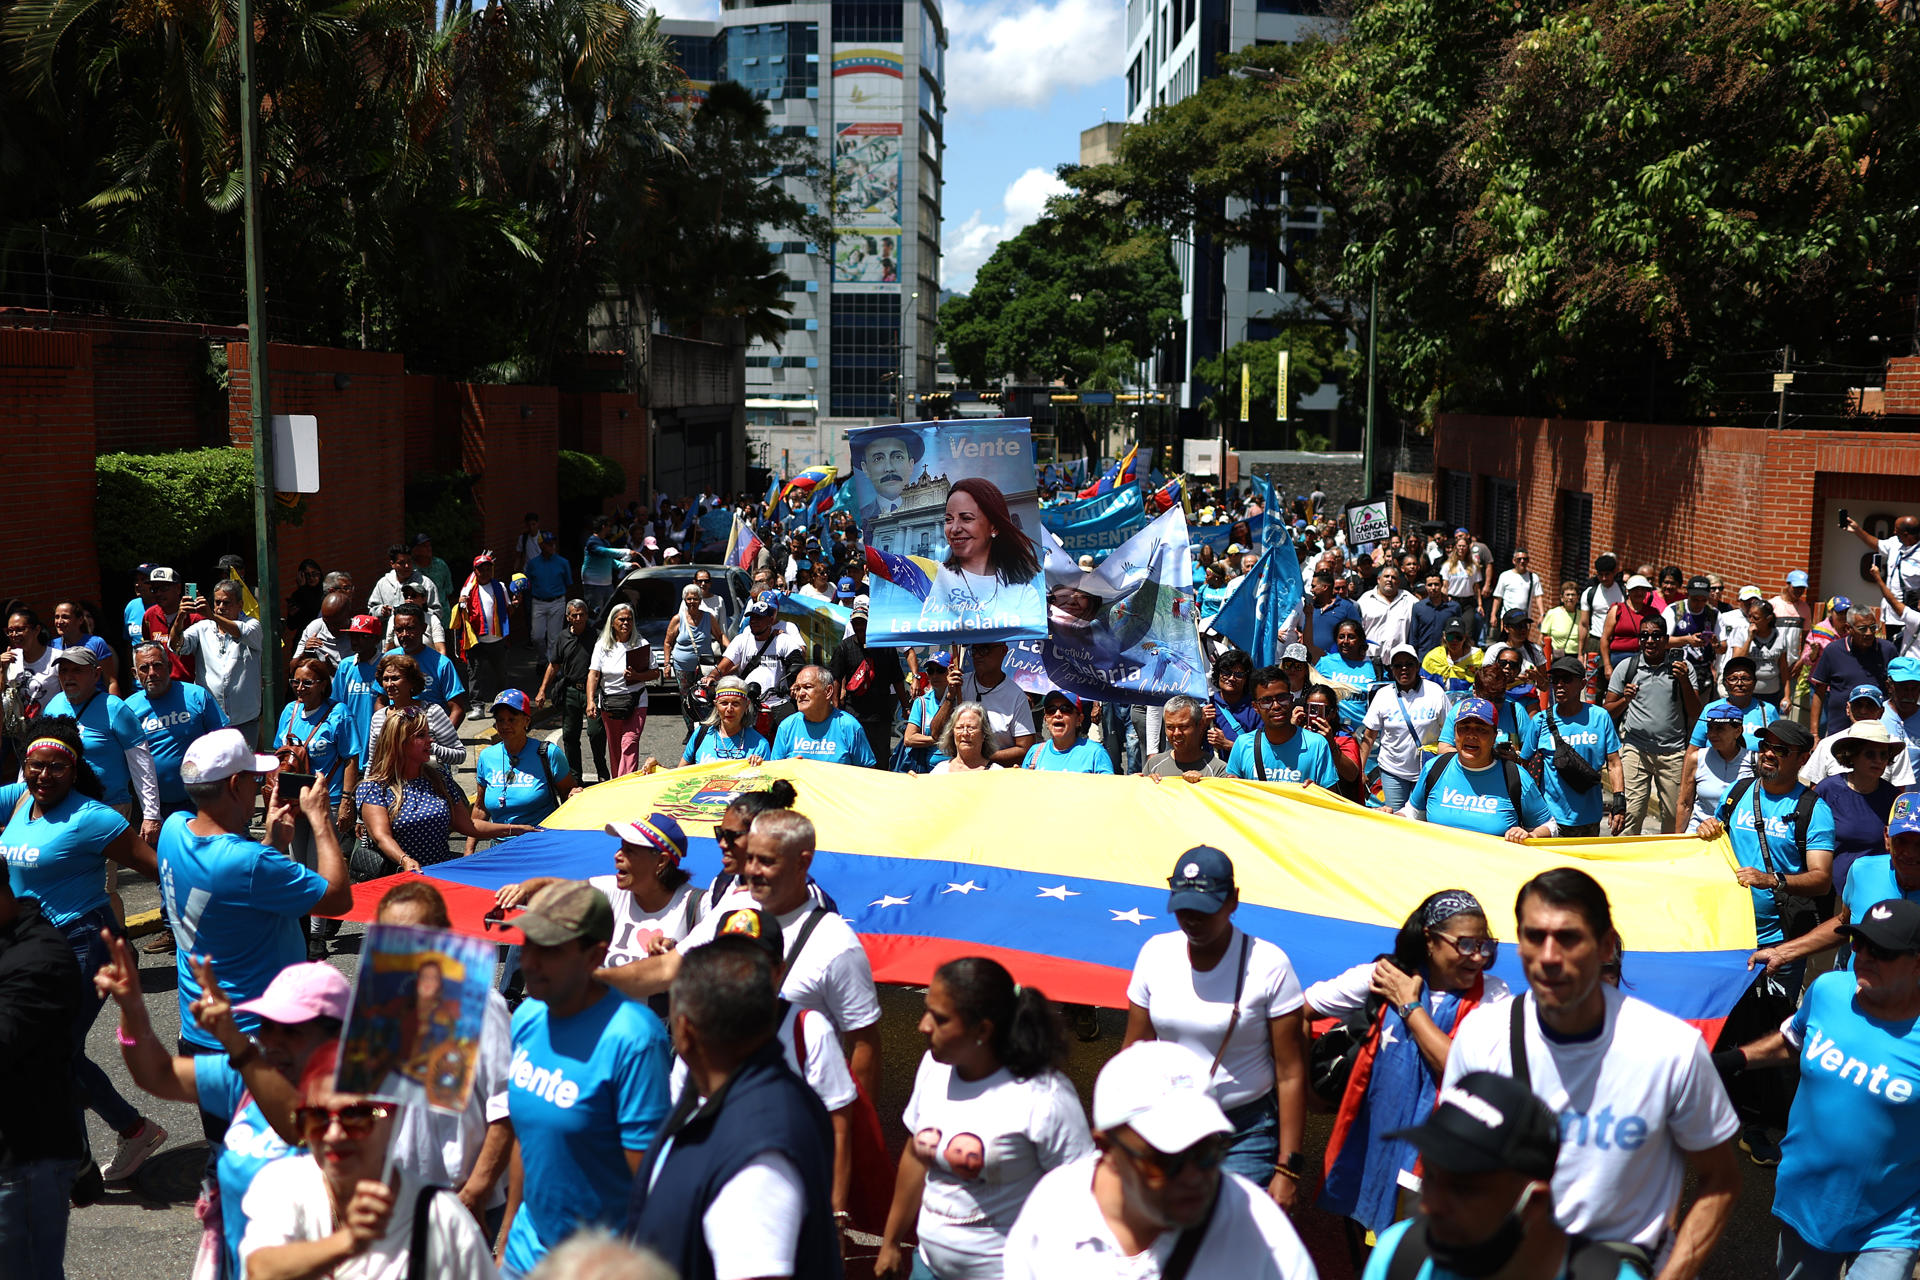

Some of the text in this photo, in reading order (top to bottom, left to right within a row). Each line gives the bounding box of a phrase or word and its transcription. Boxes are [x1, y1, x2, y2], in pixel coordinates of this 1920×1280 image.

[949, 435, 1020, 459] Vente
[1355, 520, 1388, 534] CARACAS
[890, 611, 1021, 633] La Candelaria
[794, 736, 836, 750] Vente
[1442, 786, 1498, 809] Vente
[0, 843, 40, 862] ente
[1806, 1029, 1913, 1103] Vente
[509, 1043, 579, 1119] Vente
[1559, 1104, 1648, 1150] nte
